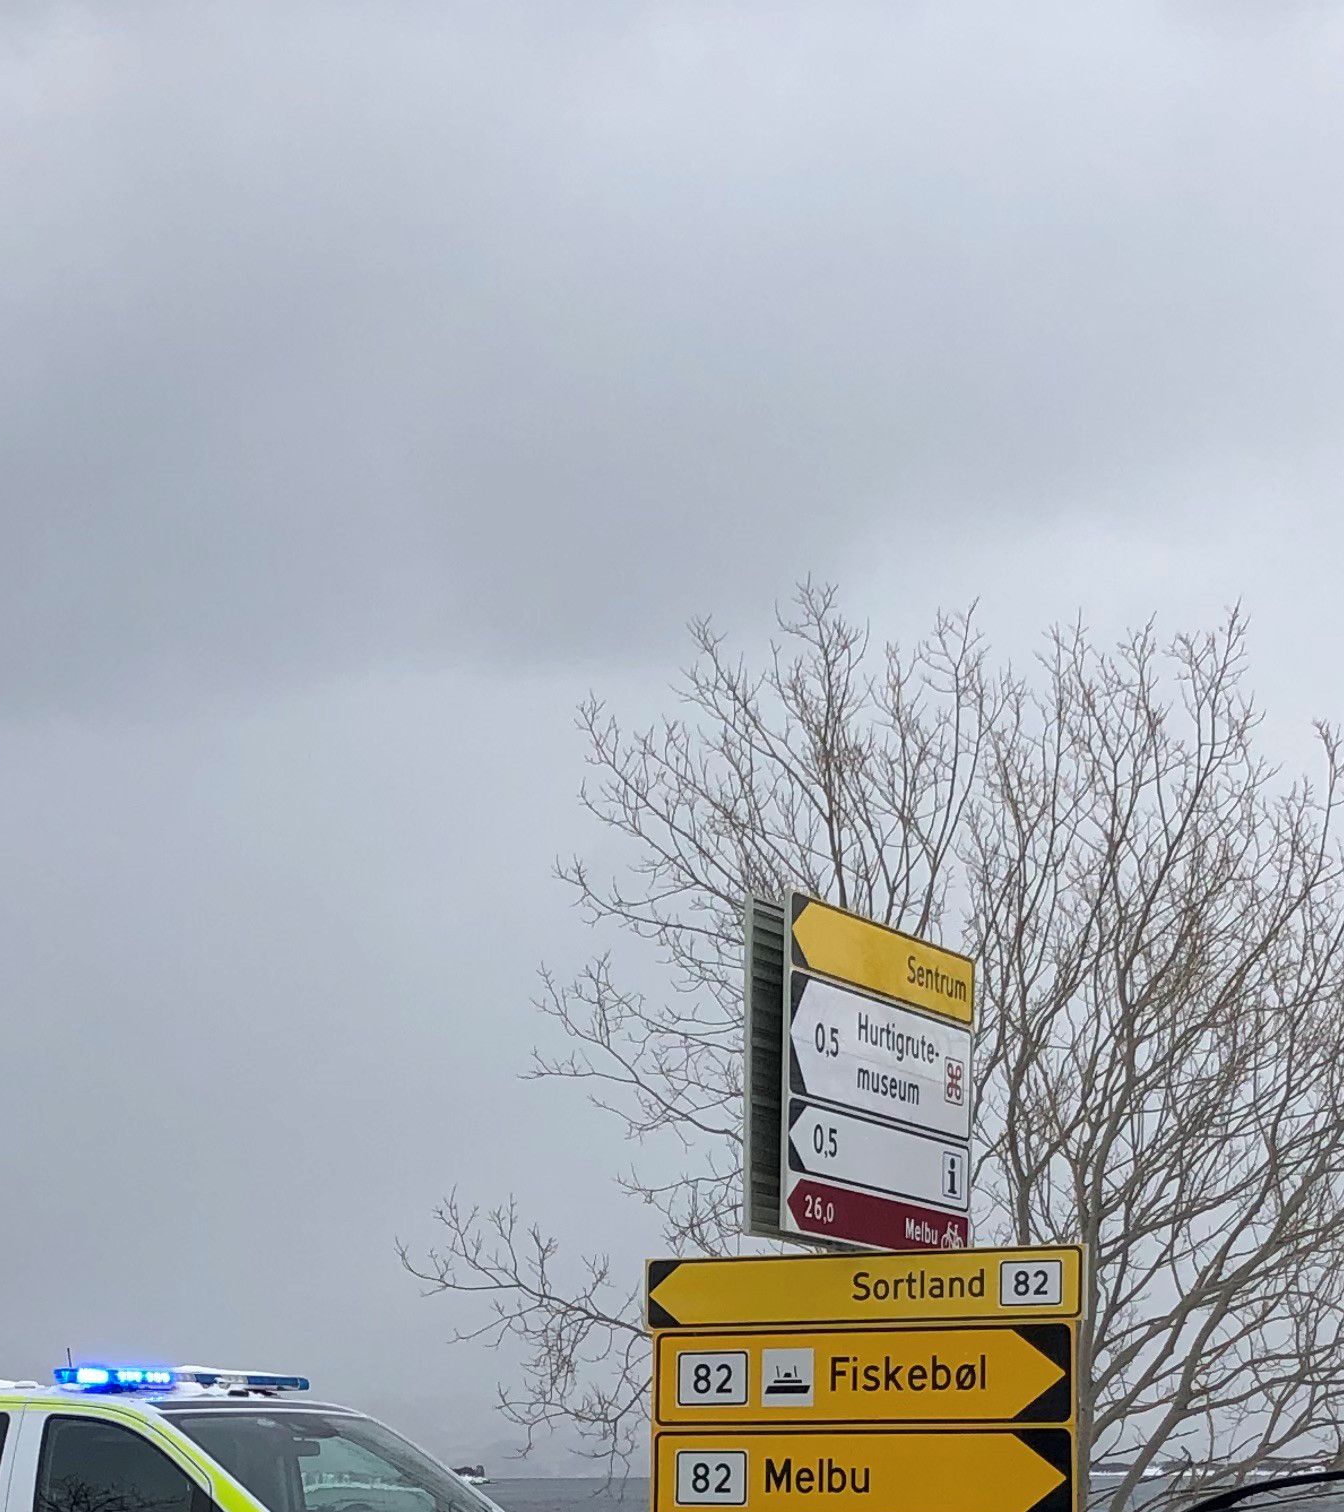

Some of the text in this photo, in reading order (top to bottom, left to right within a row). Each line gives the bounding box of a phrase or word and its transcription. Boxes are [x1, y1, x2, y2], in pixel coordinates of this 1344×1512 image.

[907, 955, 966, 1002] Sentrum
[815, 1012, 940, 1065] 0,5 Hurtigrute-
[857, 1066, 919, 1104] museum
[813, 1123, 838, 1158] 0,5
[804, 1194, 835, 1224] 26,0
[905, 1218, 938, 1246] Melbu
[851, 1268, 1049, 1301] Sortland 82
[692, 1355, 987, 1395] 82 Fiskebøl
[691, 1458, 870, 1494] 82 Melbu
